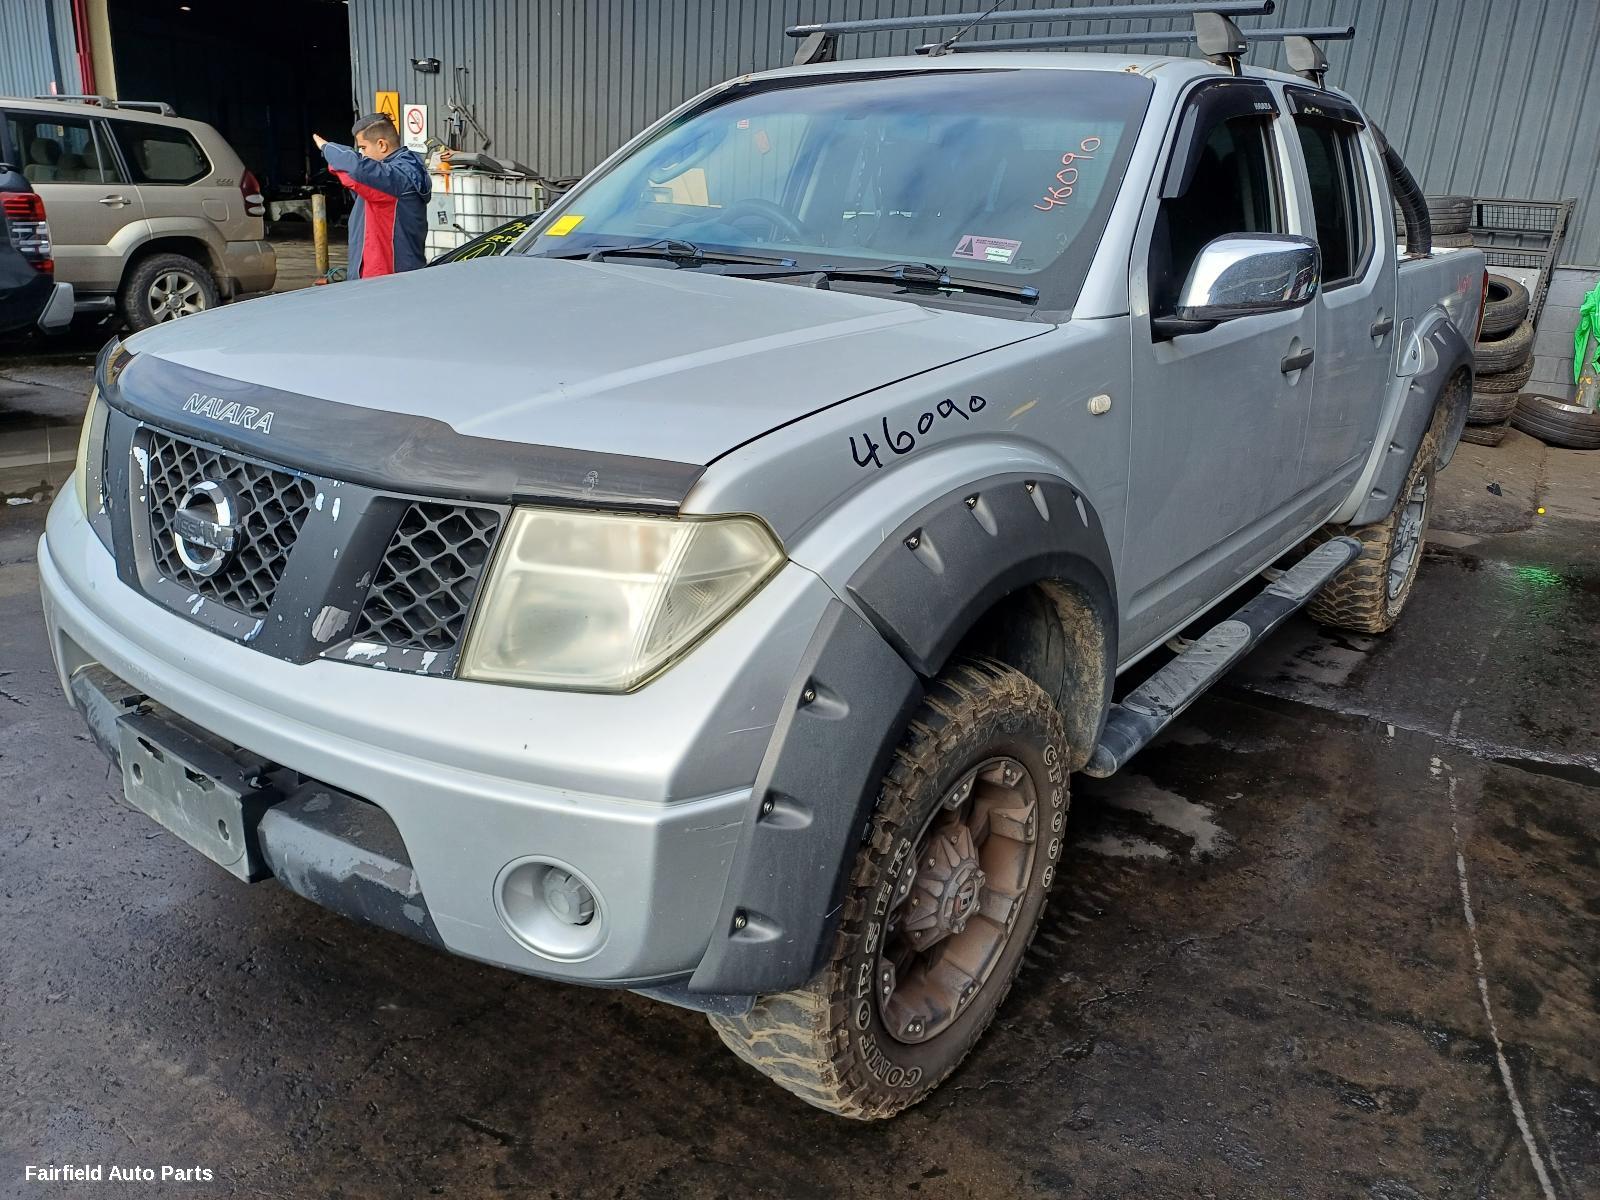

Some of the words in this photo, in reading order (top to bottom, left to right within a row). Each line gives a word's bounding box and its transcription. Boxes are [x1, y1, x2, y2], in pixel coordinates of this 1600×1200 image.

[1033, 137, 1101, 211] 46090
[182, 393, 275, 434] NAVARA
[849, 395, 987, 468] 46090
[1042, 744, 1063, 888] CF3000
[856, 837, 923, 1088] COMFORSER
